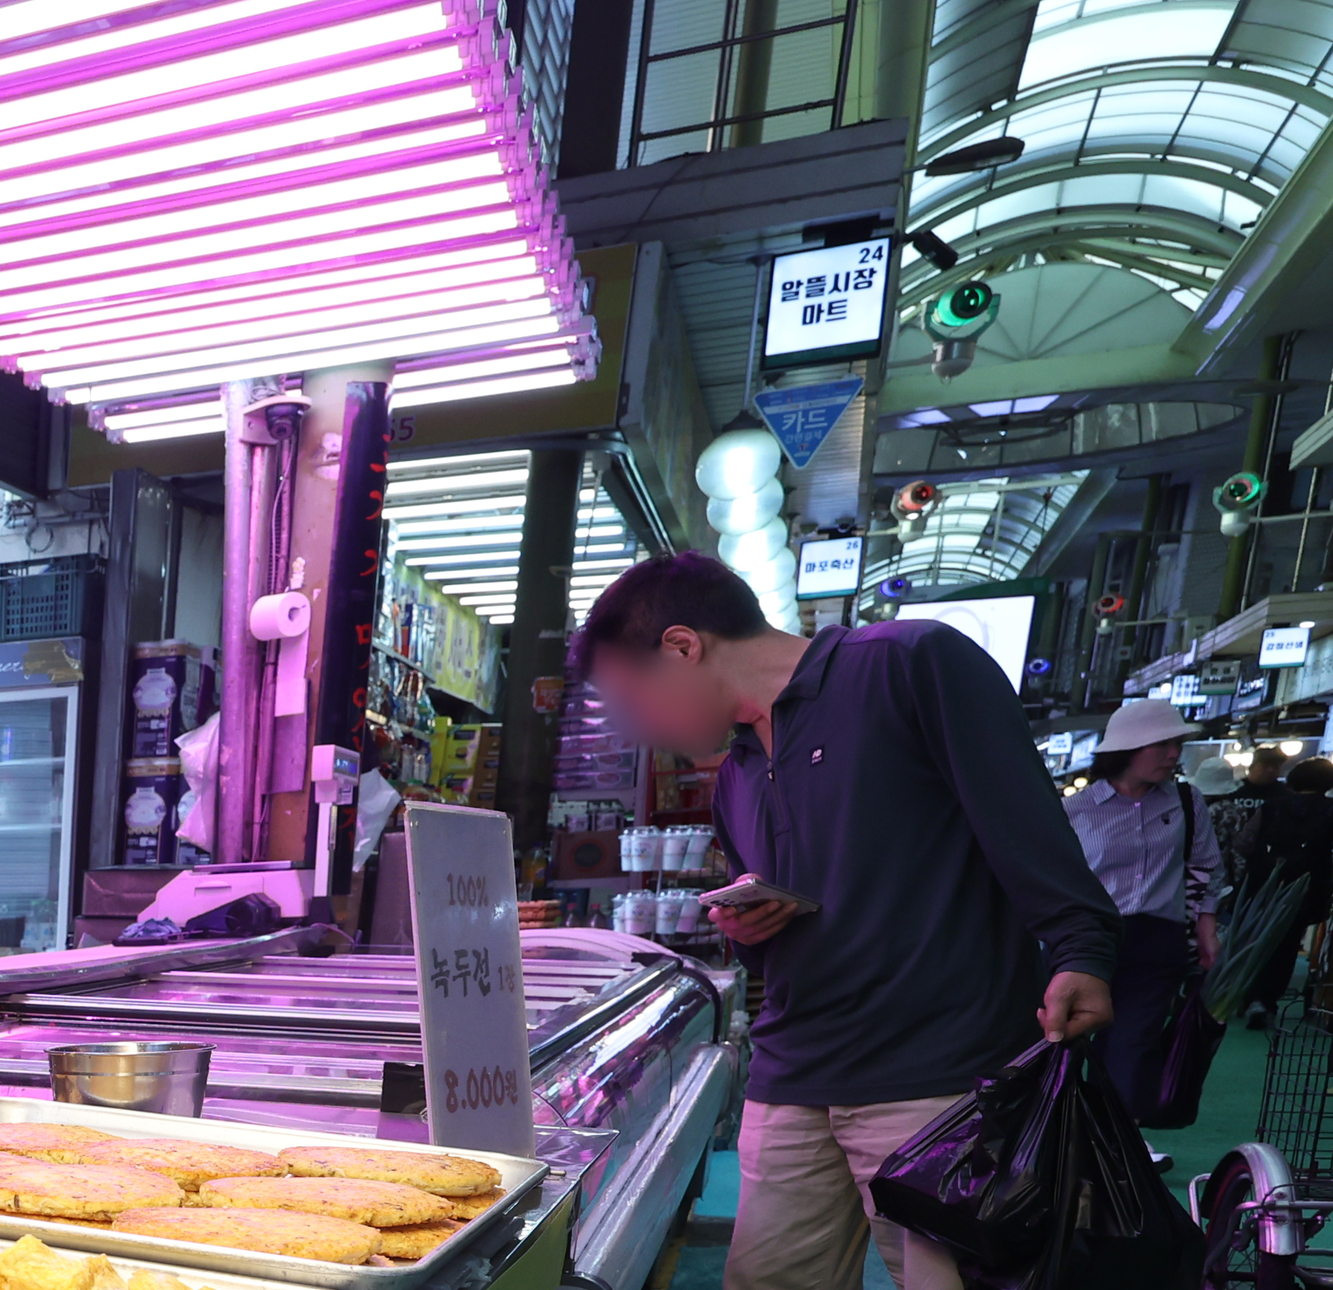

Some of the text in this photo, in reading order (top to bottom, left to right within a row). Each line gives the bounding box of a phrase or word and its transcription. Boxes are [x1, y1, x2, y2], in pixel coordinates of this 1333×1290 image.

[858, 246, 884, 266] 24
[780, 267, 879, 304] 알뜰시장
[802, 299, 848, 327] 마트
[781, 409, 829, 433] 카드
[846, 541, 859, 550] 26
[804, 558, 855, 573] 마포축산
[446, 872, 490, 907] 100%
[430, 947, 492, 998] 녹두전
[444, 1065, 519, 1114] 8.000원
